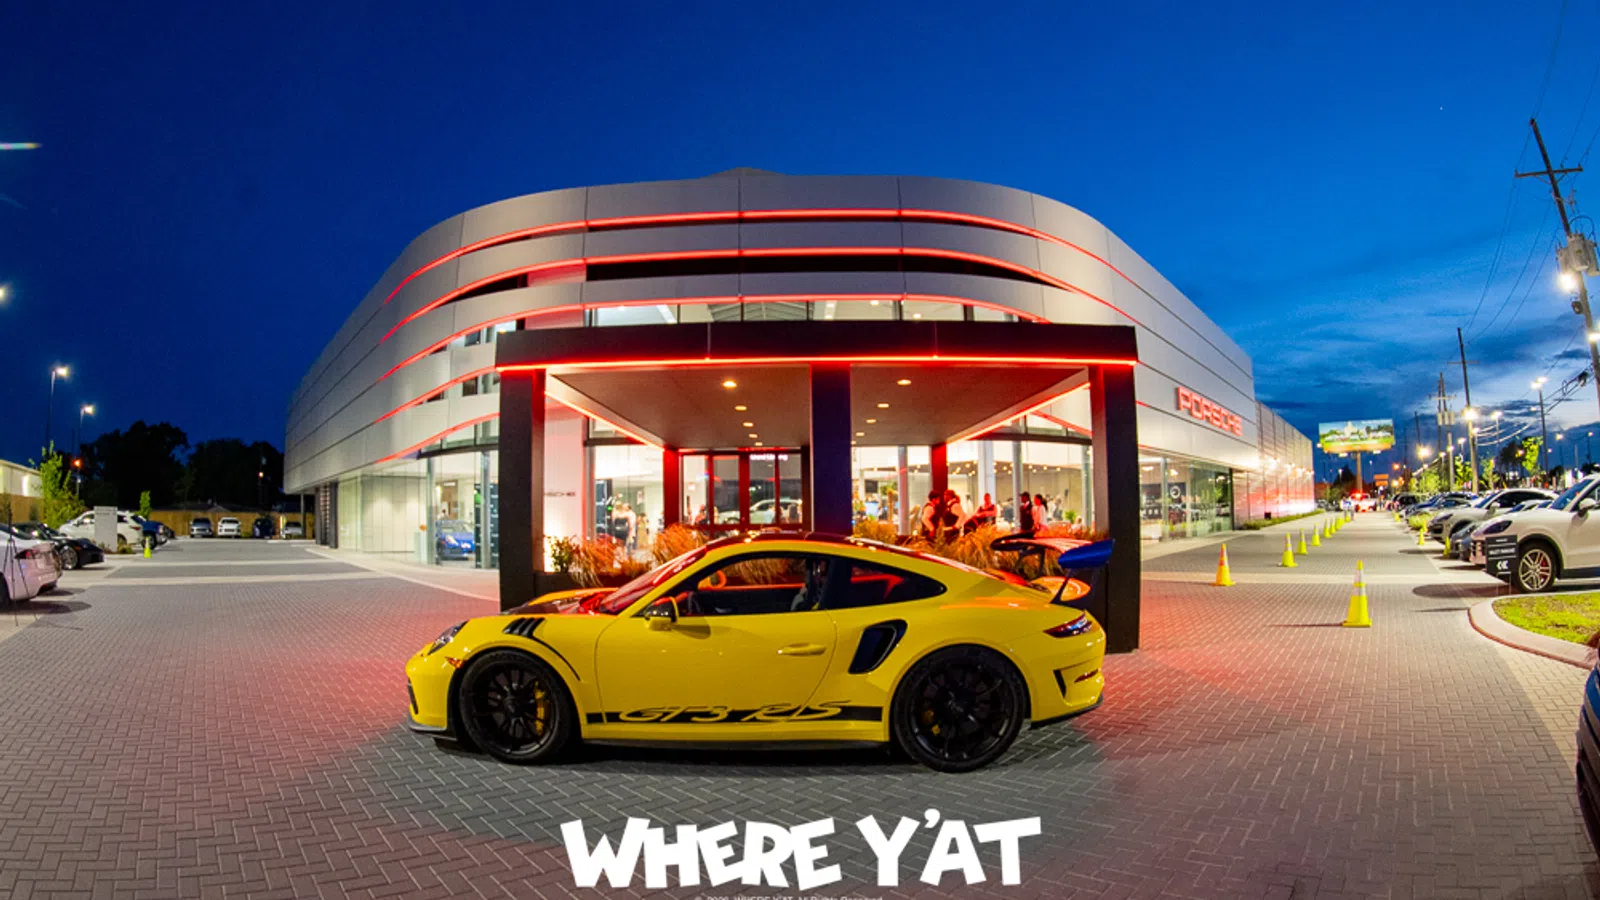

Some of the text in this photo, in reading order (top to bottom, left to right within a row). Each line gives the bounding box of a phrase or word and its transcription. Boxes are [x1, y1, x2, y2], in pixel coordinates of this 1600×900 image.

[1177, 386, 1242, 436] PORSCHE
[619, 700, 852, 722] GT3 RS
